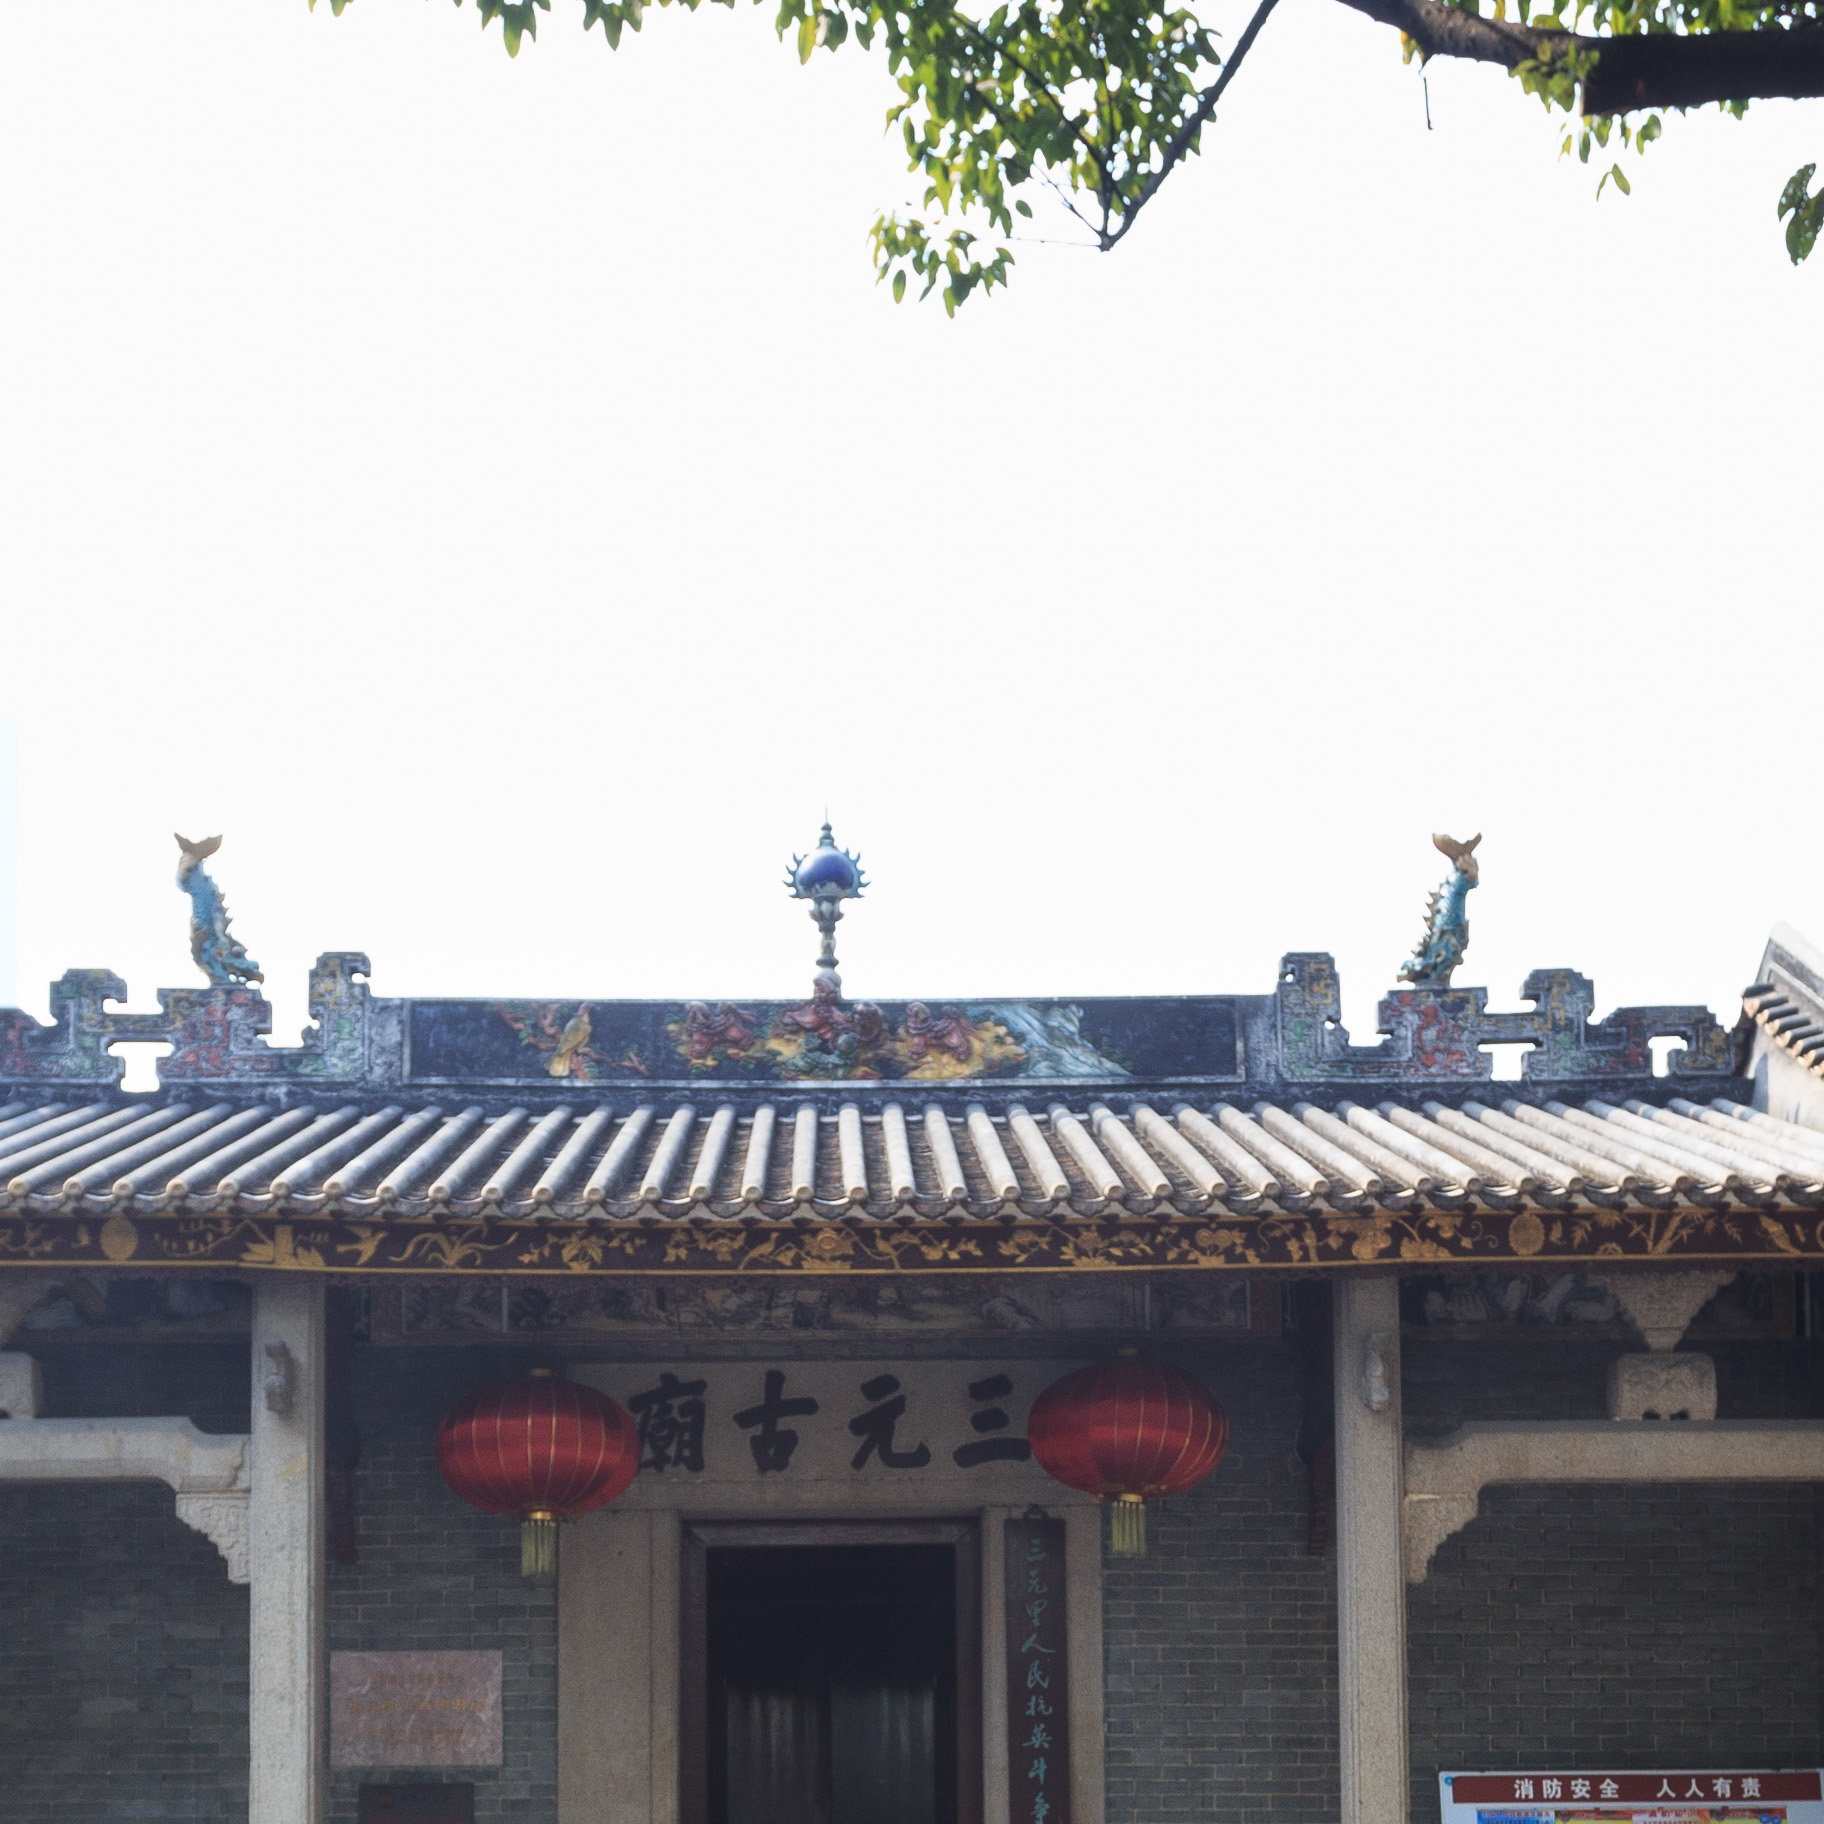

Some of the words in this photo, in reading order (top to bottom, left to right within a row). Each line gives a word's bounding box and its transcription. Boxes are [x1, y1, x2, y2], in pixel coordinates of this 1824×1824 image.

[1514, 1778, 1620, 1799] 消防安全
[1656, 1777, 1762, 1798] 人人有责
